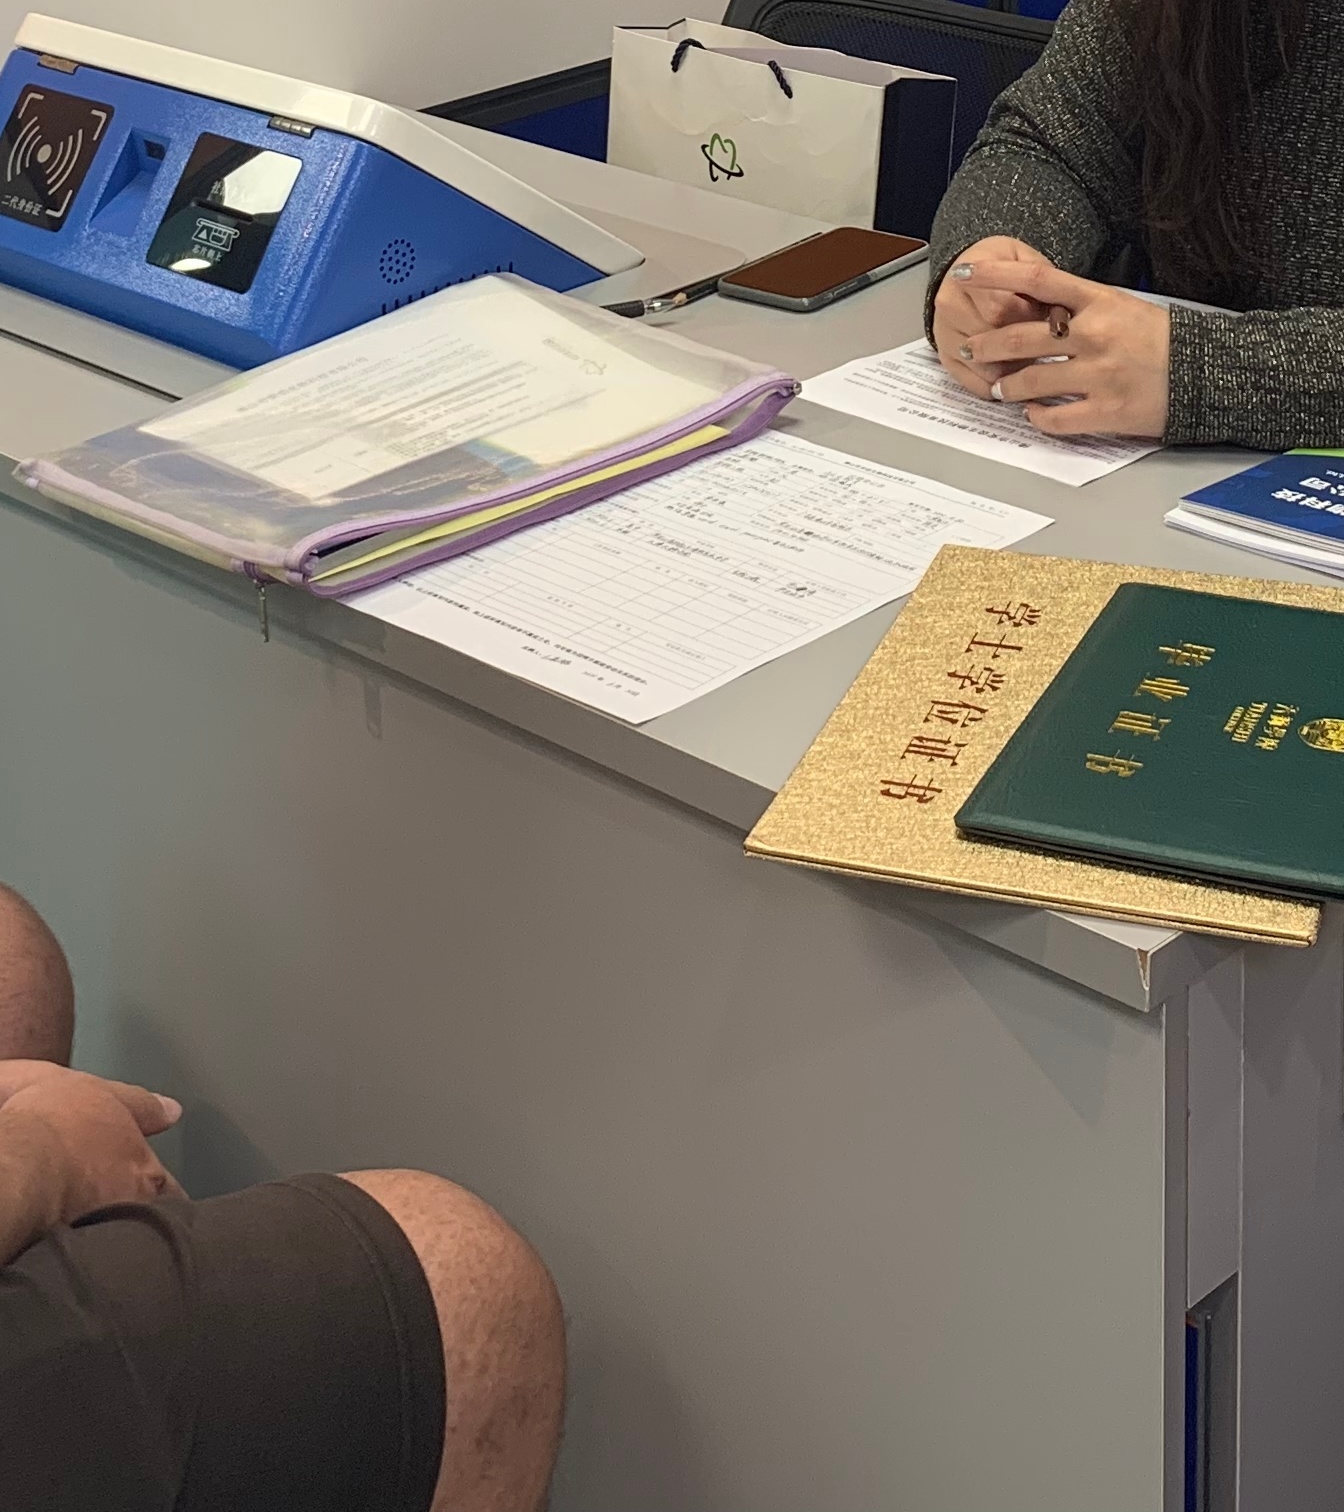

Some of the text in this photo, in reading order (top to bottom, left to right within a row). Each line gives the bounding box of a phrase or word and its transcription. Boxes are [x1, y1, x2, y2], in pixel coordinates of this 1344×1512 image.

[879, 600, 1042, 805] 学士学位证书
